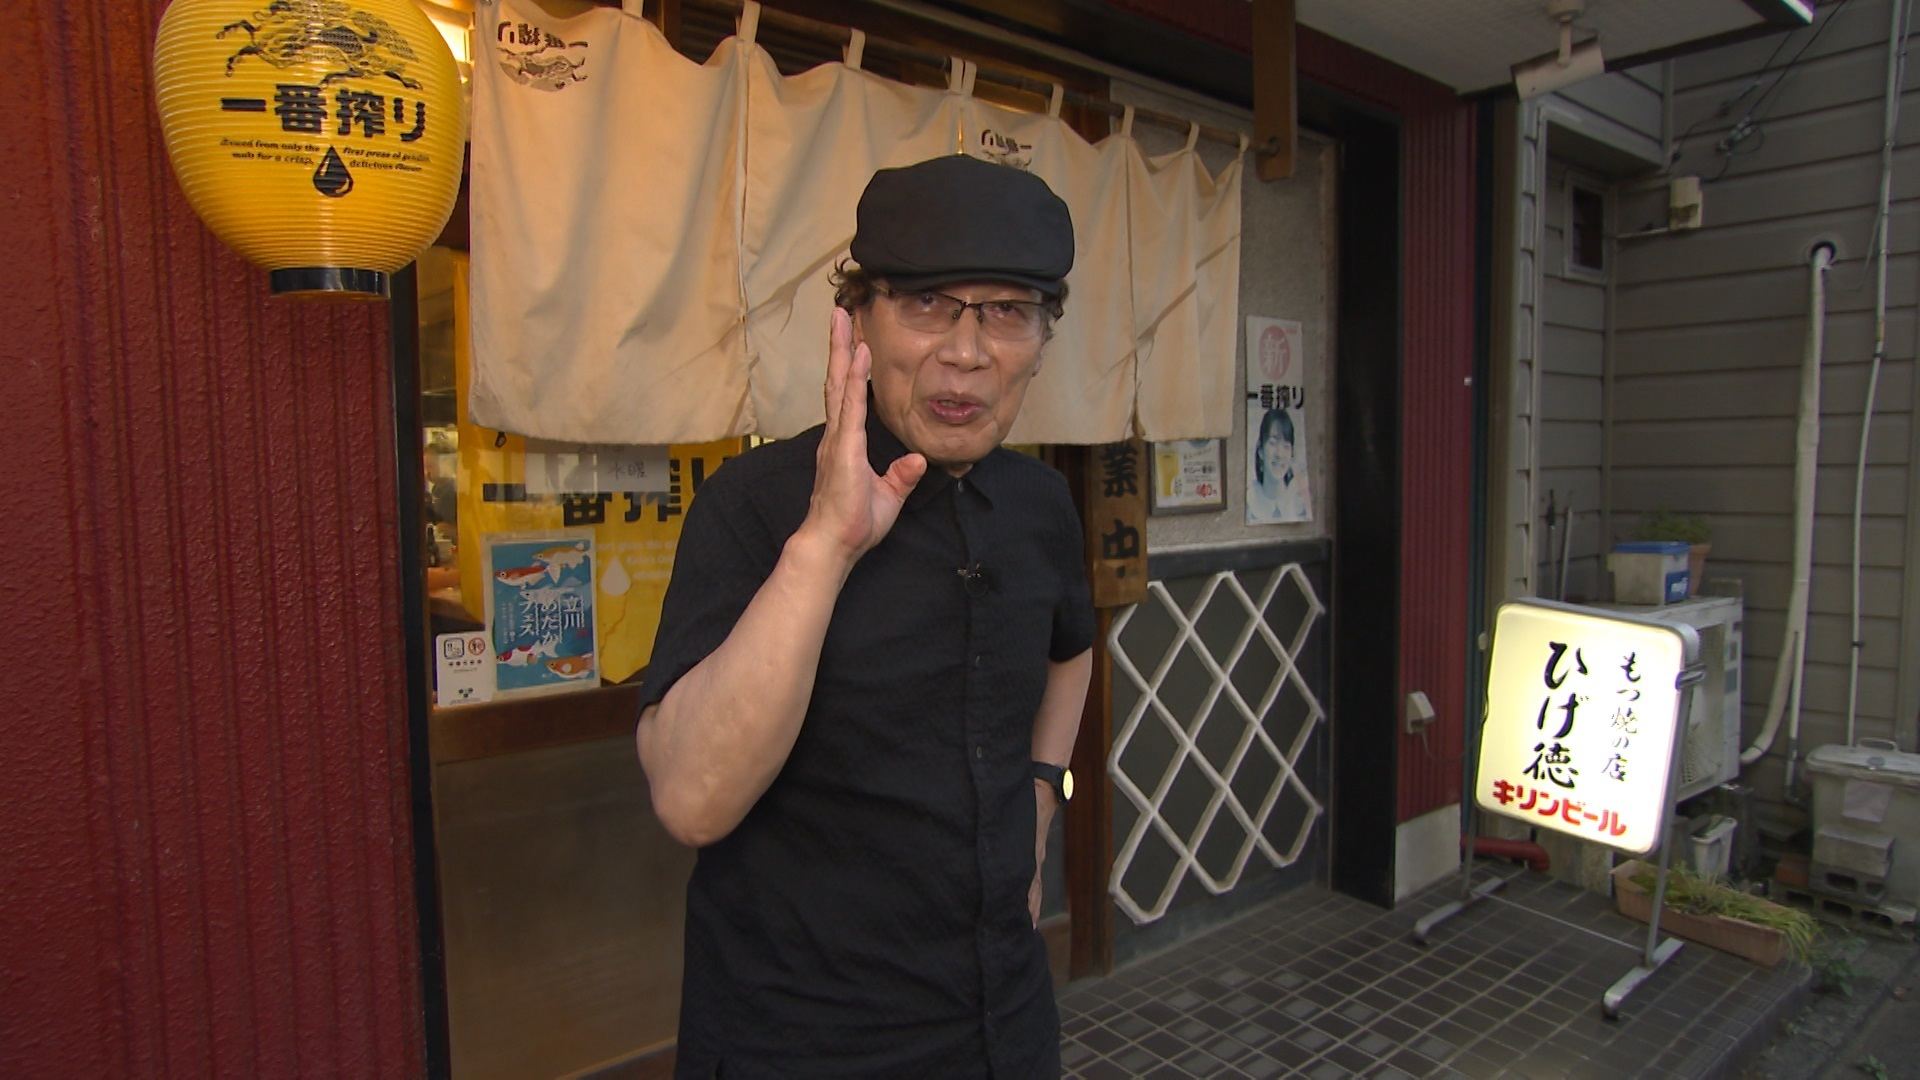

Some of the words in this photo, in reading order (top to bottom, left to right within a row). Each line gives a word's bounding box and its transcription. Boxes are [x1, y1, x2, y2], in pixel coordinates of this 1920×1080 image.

[220, 83, 426, 142] 一番搾り
[255, 139, 279, 150] from
[281, 142, 304, 152] only
[304, 144, 321, 152] the
[343, 146, 365, 155] first
[1263, 333, 1288, 375] 新
[1247, 383, 1304, 409] 一番搾り
[519, 598, 536, 638] フェス
[562, 595, 581, 630] 立川
[1523, 641, 1590, 790] ひげ徳
[1601, 651, 1642, 783] もつ焼の店
[1492, 779, 1628, 837] キリンビール
